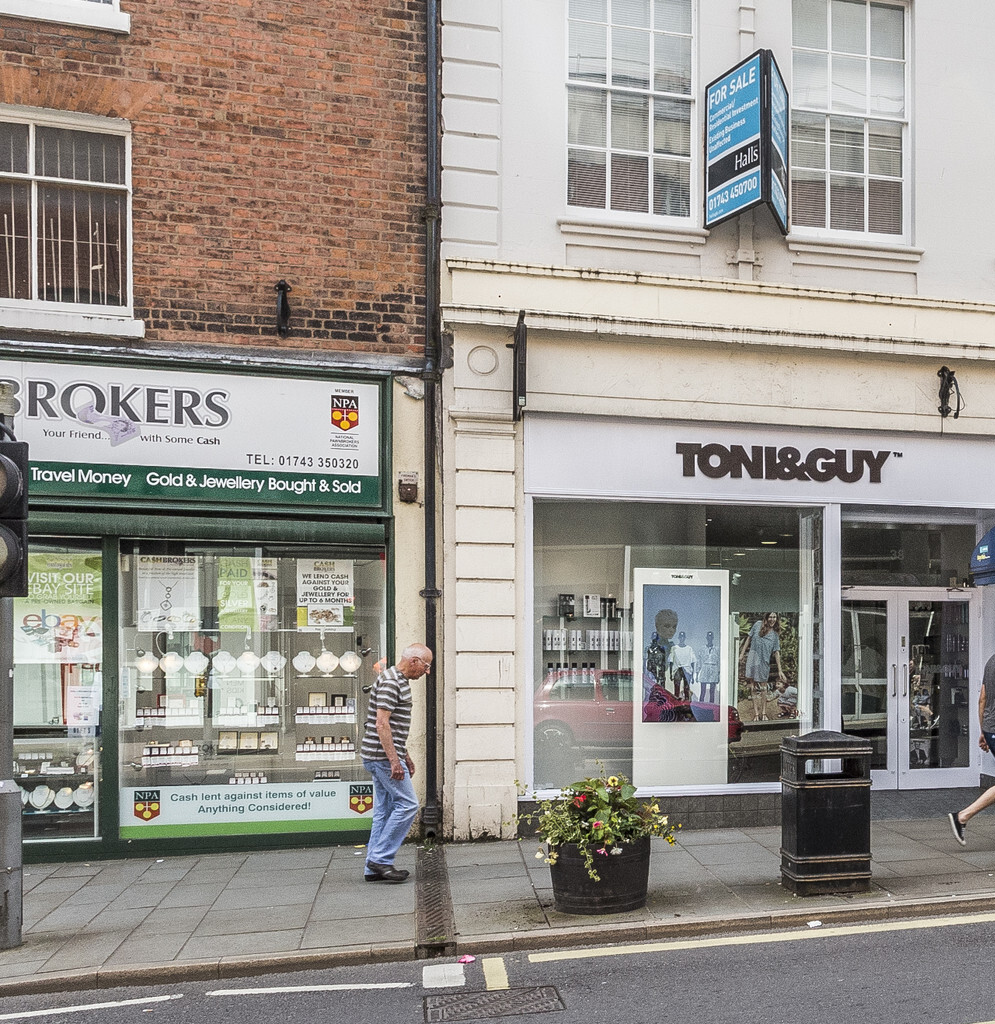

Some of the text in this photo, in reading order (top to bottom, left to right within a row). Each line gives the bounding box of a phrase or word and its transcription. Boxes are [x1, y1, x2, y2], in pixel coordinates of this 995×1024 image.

[709, 66, 756, 110] FOR SALE
[735, 146, 759, 171] Halls
[709, 192, 729, 211] 01743
[730, 176, 758, 199] 450700
[333, 397, 357, 409] NPA
[43, 429, 66, 438] Your
[140, 434, 161, 443] with
[165, 435, 193, 444] Some
[197, 436, 220, 445] Cash
[247, 454, 359, 469] TEL: 01743 350320
[676, 442, 891, 484] TONI&GUY
[31, 467, 131, 487] Travel Money
[146, 472, 361, 494] Gold & Jewellery Bought & Sold
[28, 572, 94, 584] VISIT OUR
[220, 568, 248, 577] PAID
[65, 584, 94, 595] SITE
[220, 599, 249, 607] SILVER
[23, 609, 98, 632] ebay
[135, 791, 159, 800] NPA
[170, 789, 336, 803] Cash lent against items of value
[351, 785, 373, 794] NPA
[198, 802, 311, 815] Anything Considered!
